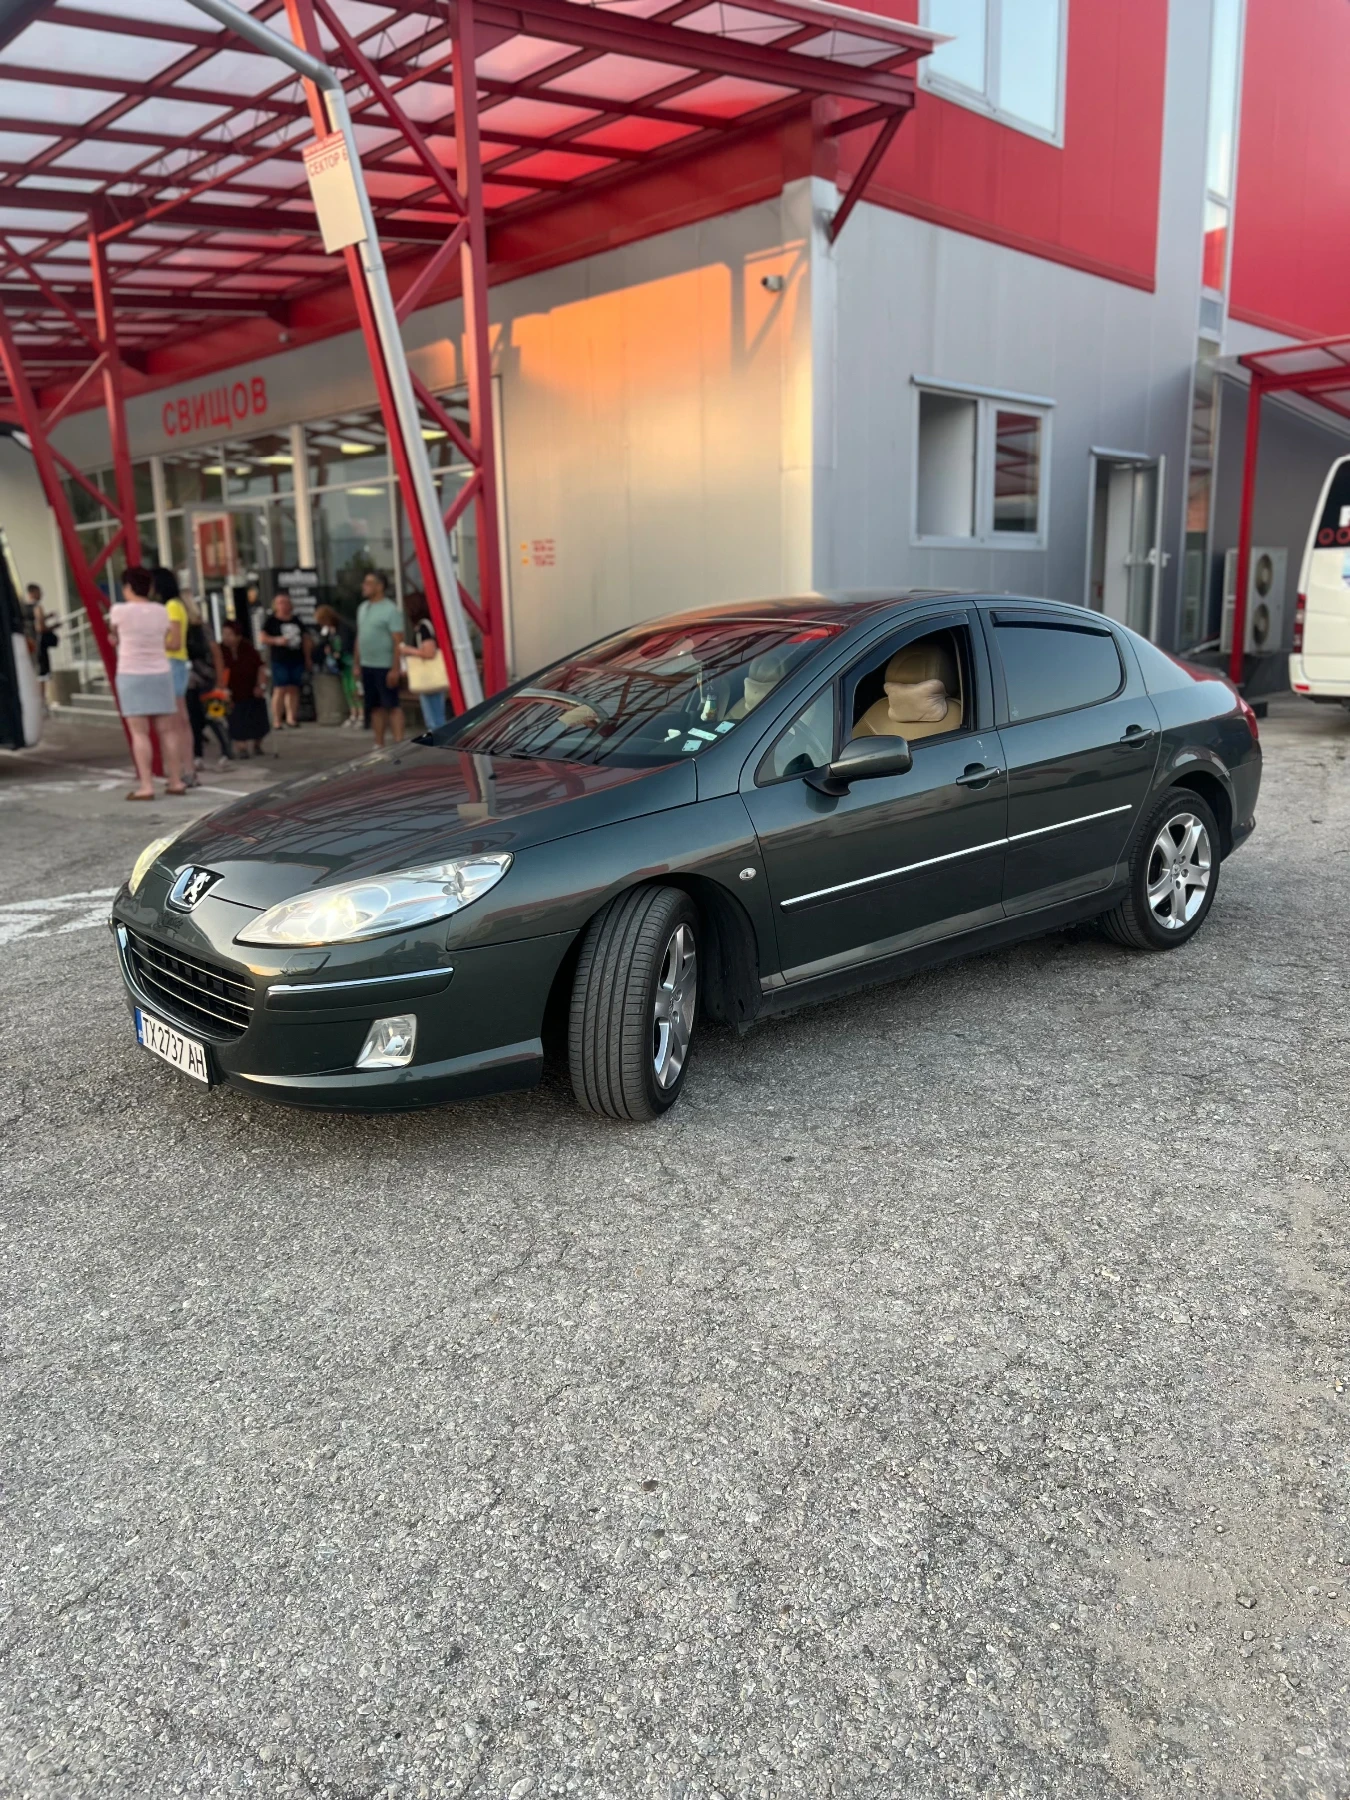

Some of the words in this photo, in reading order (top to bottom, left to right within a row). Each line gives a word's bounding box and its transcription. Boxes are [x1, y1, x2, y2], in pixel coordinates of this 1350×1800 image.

[308, 151, 341, 177] СЕКТОР
[162, 376, 267, 437] СВИЩОВ
[188, 1043, 205, 1077] AH
